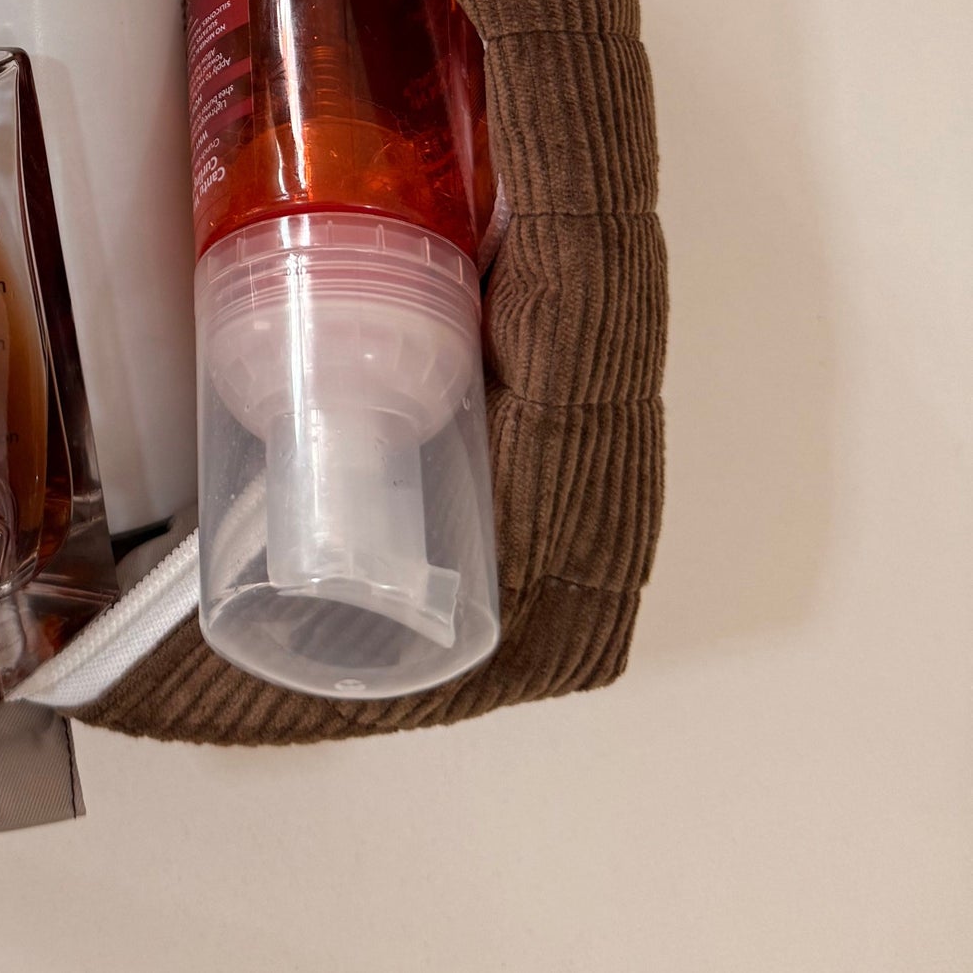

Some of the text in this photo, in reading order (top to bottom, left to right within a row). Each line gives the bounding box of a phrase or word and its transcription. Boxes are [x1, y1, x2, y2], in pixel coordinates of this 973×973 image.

[215, 23, 226, 35] NO
[212, 57, 231, 75] Apply
[199, 166, 226, 197] Cantu
